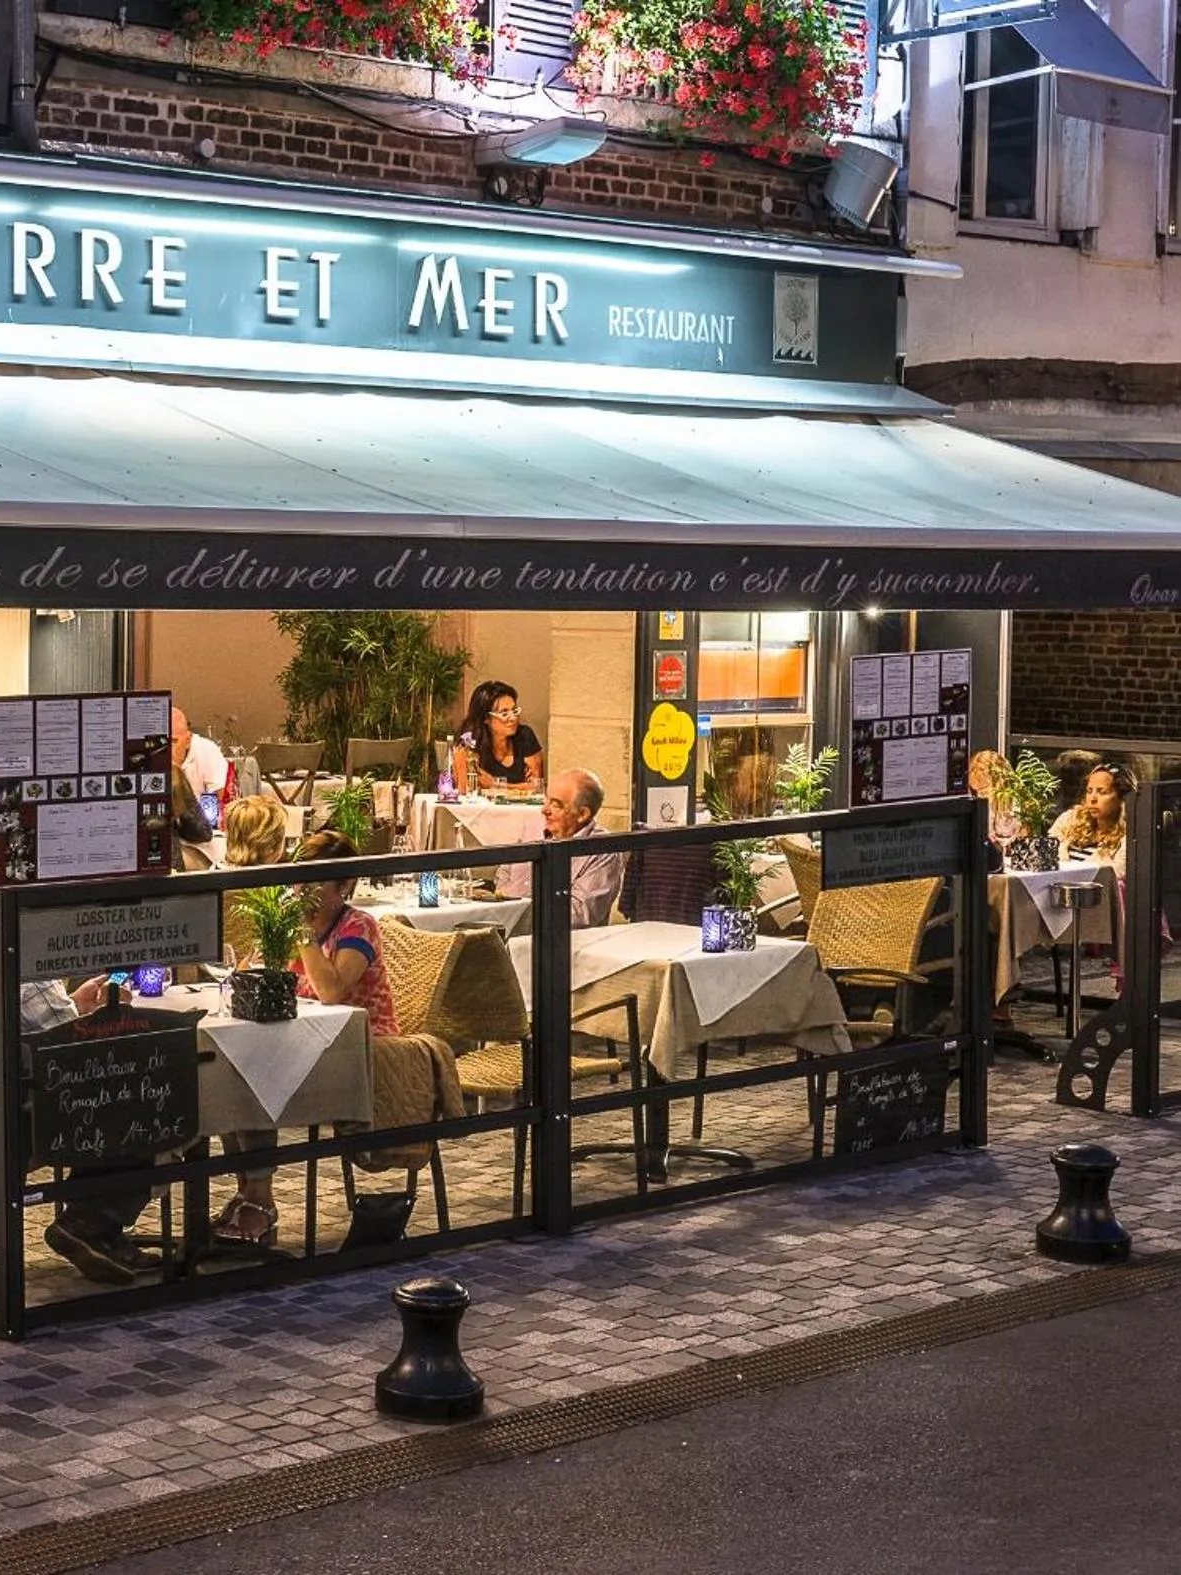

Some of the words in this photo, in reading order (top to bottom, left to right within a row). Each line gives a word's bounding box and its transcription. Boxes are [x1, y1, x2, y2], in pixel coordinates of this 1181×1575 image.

[259, 246, 341, 321] ET
[408, 252, 570, 339] MER
[608, 305, 735, 346] RESTAURANT
[20, 545, 83, 590] de
[97, 557, 149, 590] se
[165, 547, 359, 591] délivrer
[373, 547, 503, 591] d'une
[514, 560, 697, 592] tentation
[710, 555, 790, 593] c'est
[800, 557, 857, 607] d'y
[869, 560, 1041, 594] succomber.
[76, 906, 126, 928] LOBSTER
[128, 904, 162, 923] MENU
[47, 933, 81, 952] ALIVE
[83, 930, 112, 949] BLUE
[113, 924, 164, 946] LOBSTER
[35, 953, 89, 973] DIRECTLY
[91, 950, 123, 968] FROM
[124, 948, 147, 963] THE
[148, 942, 199, 960] TRAWLER
